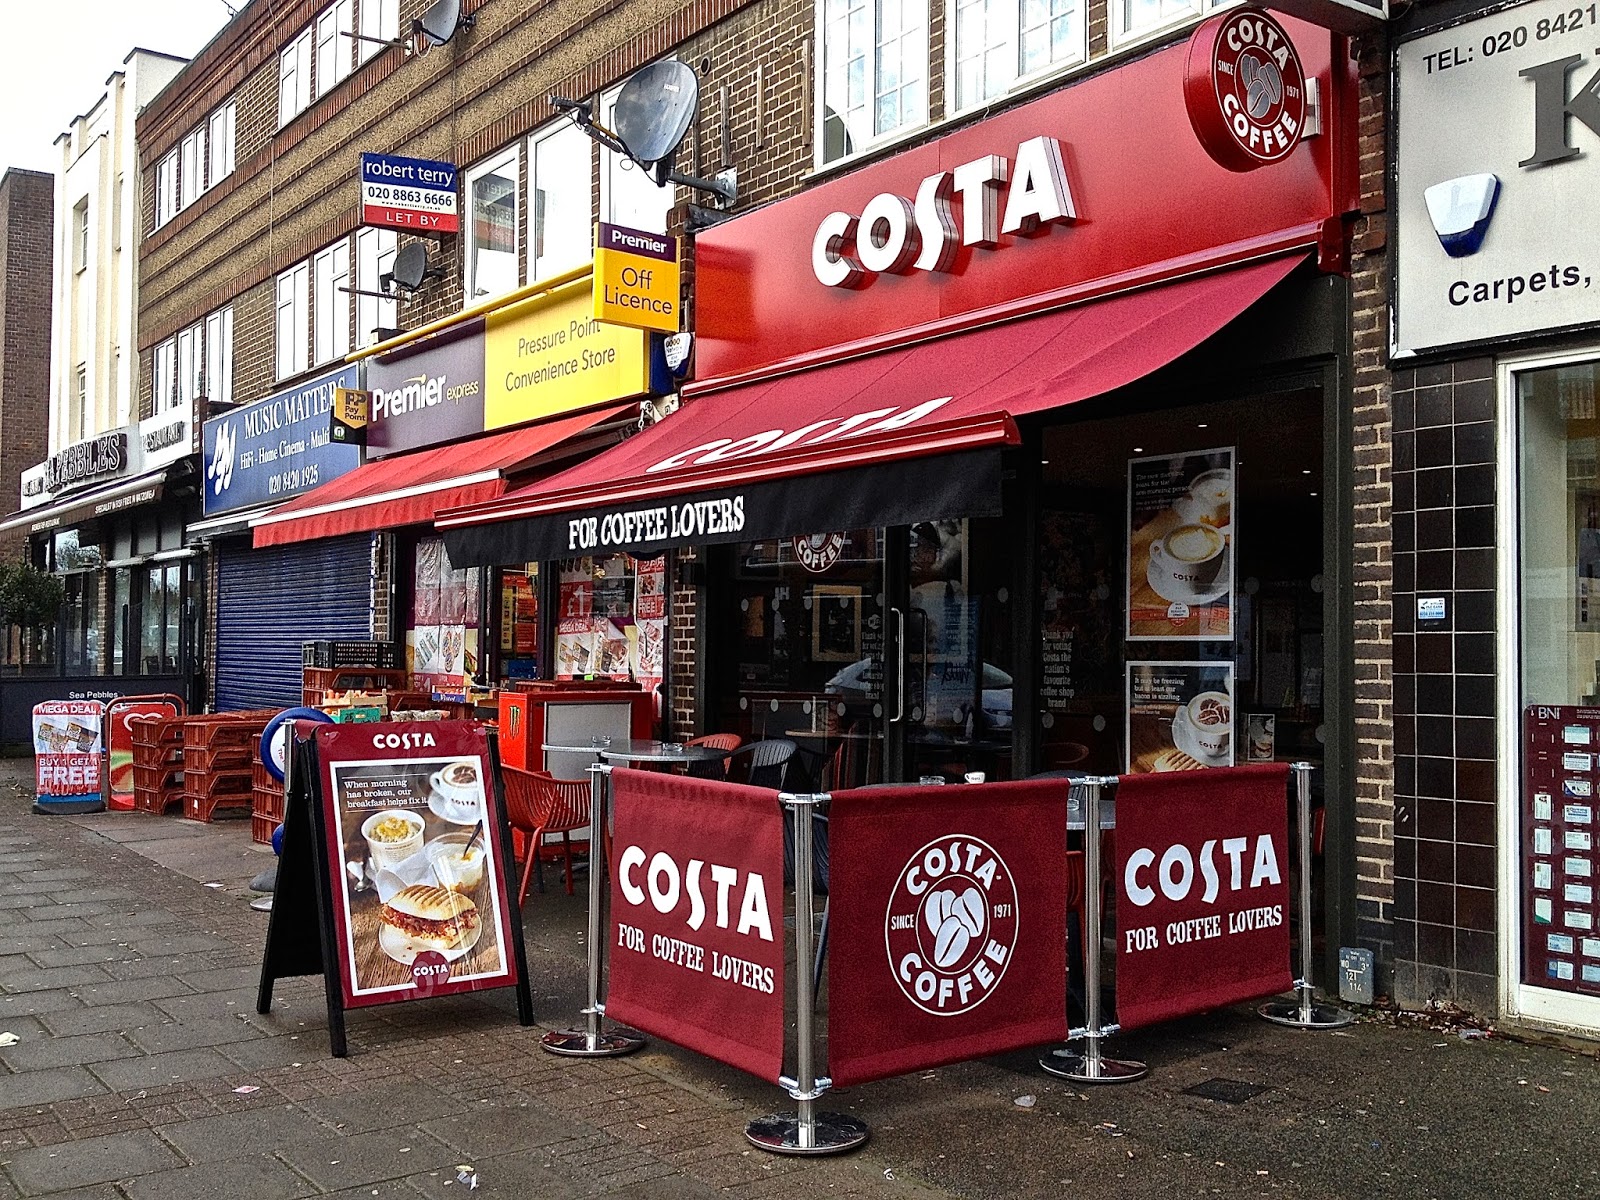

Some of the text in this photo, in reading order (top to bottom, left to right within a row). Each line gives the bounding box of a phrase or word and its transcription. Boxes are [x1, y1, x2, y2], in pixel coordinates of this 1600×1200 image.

[1227, 19, 1290, 71] COSTA
[1423, 3, 1597, 75] TEL: 020 8421
[1218, 60, 1299, 99] SINCE 1971
[1224, 94, 1297, 153] COFFEE
[366, 160, 453, 187] robert terry
[368, 187, 452, 206] 020 8863 6666
[386, 212, 439, 226] LET BY
[812, 135, 1076, 287] COSTA
[611, 229, 667, 253] Premier
[621, 267, 652, 290] Off
[1448, 265, 1591, 306] Carpets,
[605, 284, 673, 315] Licence
[518, 316, 600, 357] Pressure Point
[505, 347, 616, 392] Convenience Store
[345, 406, 359, 414] Pay
[372, 374, 479, 422] Premier express
[244, 401, 282, 439] MUSIC
[345, 413, 365, 421] Point
[645, 396, 953, 473] COSTA
[56, 433, 120, 483] PEBBLES
[240, 452, 254, 470] HiFi
[258, 447, 278, 464] Home
[279, 440, 305, 458] Cinema
[268, 465, 319, 494] 020 8420 1925
[569, 495, 745, 550] FOR COFFEE LOVERS
[798, 534, 842, 568] COFFEE
[1173, 572, 1200, 582] COSTA
[1052, 641, 1072, 653] voting
[1061, 652, 1071, 662] the
[69, 690, 118, 699] Sea Pebbles
[1059, 686, 1075, 699] shop
[1161, 677, 1185, 687] freezing
[38, 705, 96, 714] MEGA DEAL
[1538, 706, 1560, 720] BNI
[372, 733, 436, 750] COSTA
[40, 758, 59, 766] BUY
[70, 757, 89, 766] GET
[40, 766, 98, 785] FREE
[344, 779, 407, 789] When morning
[347, 799, 387, 808] breakfast
[387, 798, 408, 807] helps
[409, 796, 420, 805] fix
[364, 789, 395, 798] broken,
[397, 788, 412, 796] our
[451, 798, 475, 807] COSTA
[906, 842, 998, 895] COSTA
[1125, 834, 1281, 906] COSTA
[619, 845, 774, 942] COSTA
[891, 904, 1011, 930] SINCE 1971
[1125, 905, 1282, 953] FOR COFFEE LOVERS
[413, 964, 448, 976] COSTA
[618, 923, 774, 994] FOR COFFEE LOVERS
[900, 939, 1008, 1007] COFFEE
[1350, 982, 1361, 992] 114
